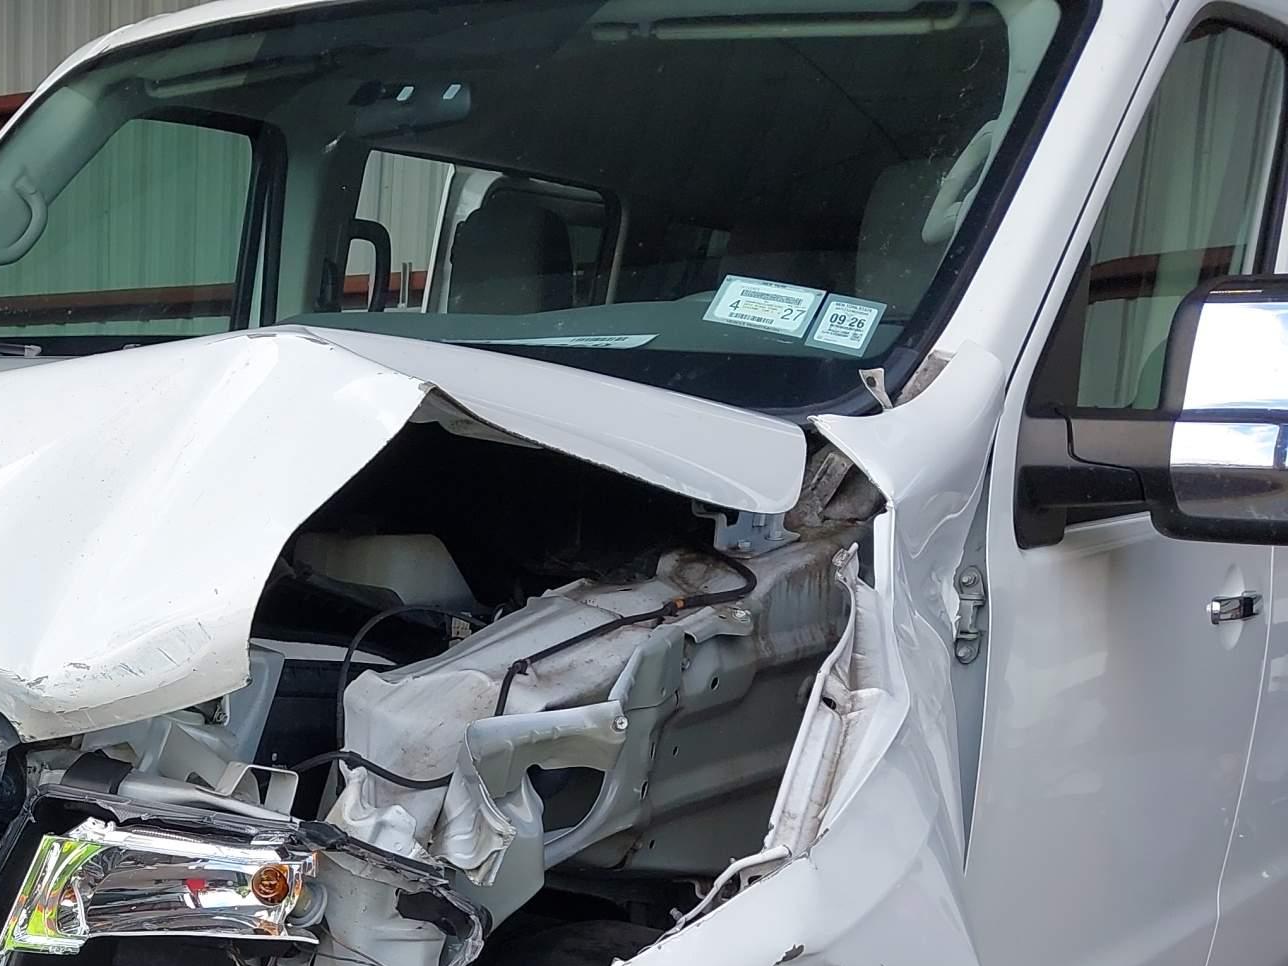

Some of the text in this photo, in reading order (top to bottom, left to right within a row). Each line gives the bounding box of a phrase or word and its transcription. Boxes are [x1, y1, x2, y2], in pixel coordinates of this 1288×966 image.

[729, 299, 741, 311] 4
[781, 308, 806, 321] 27
[830, 313, 867, 329] 09 26
